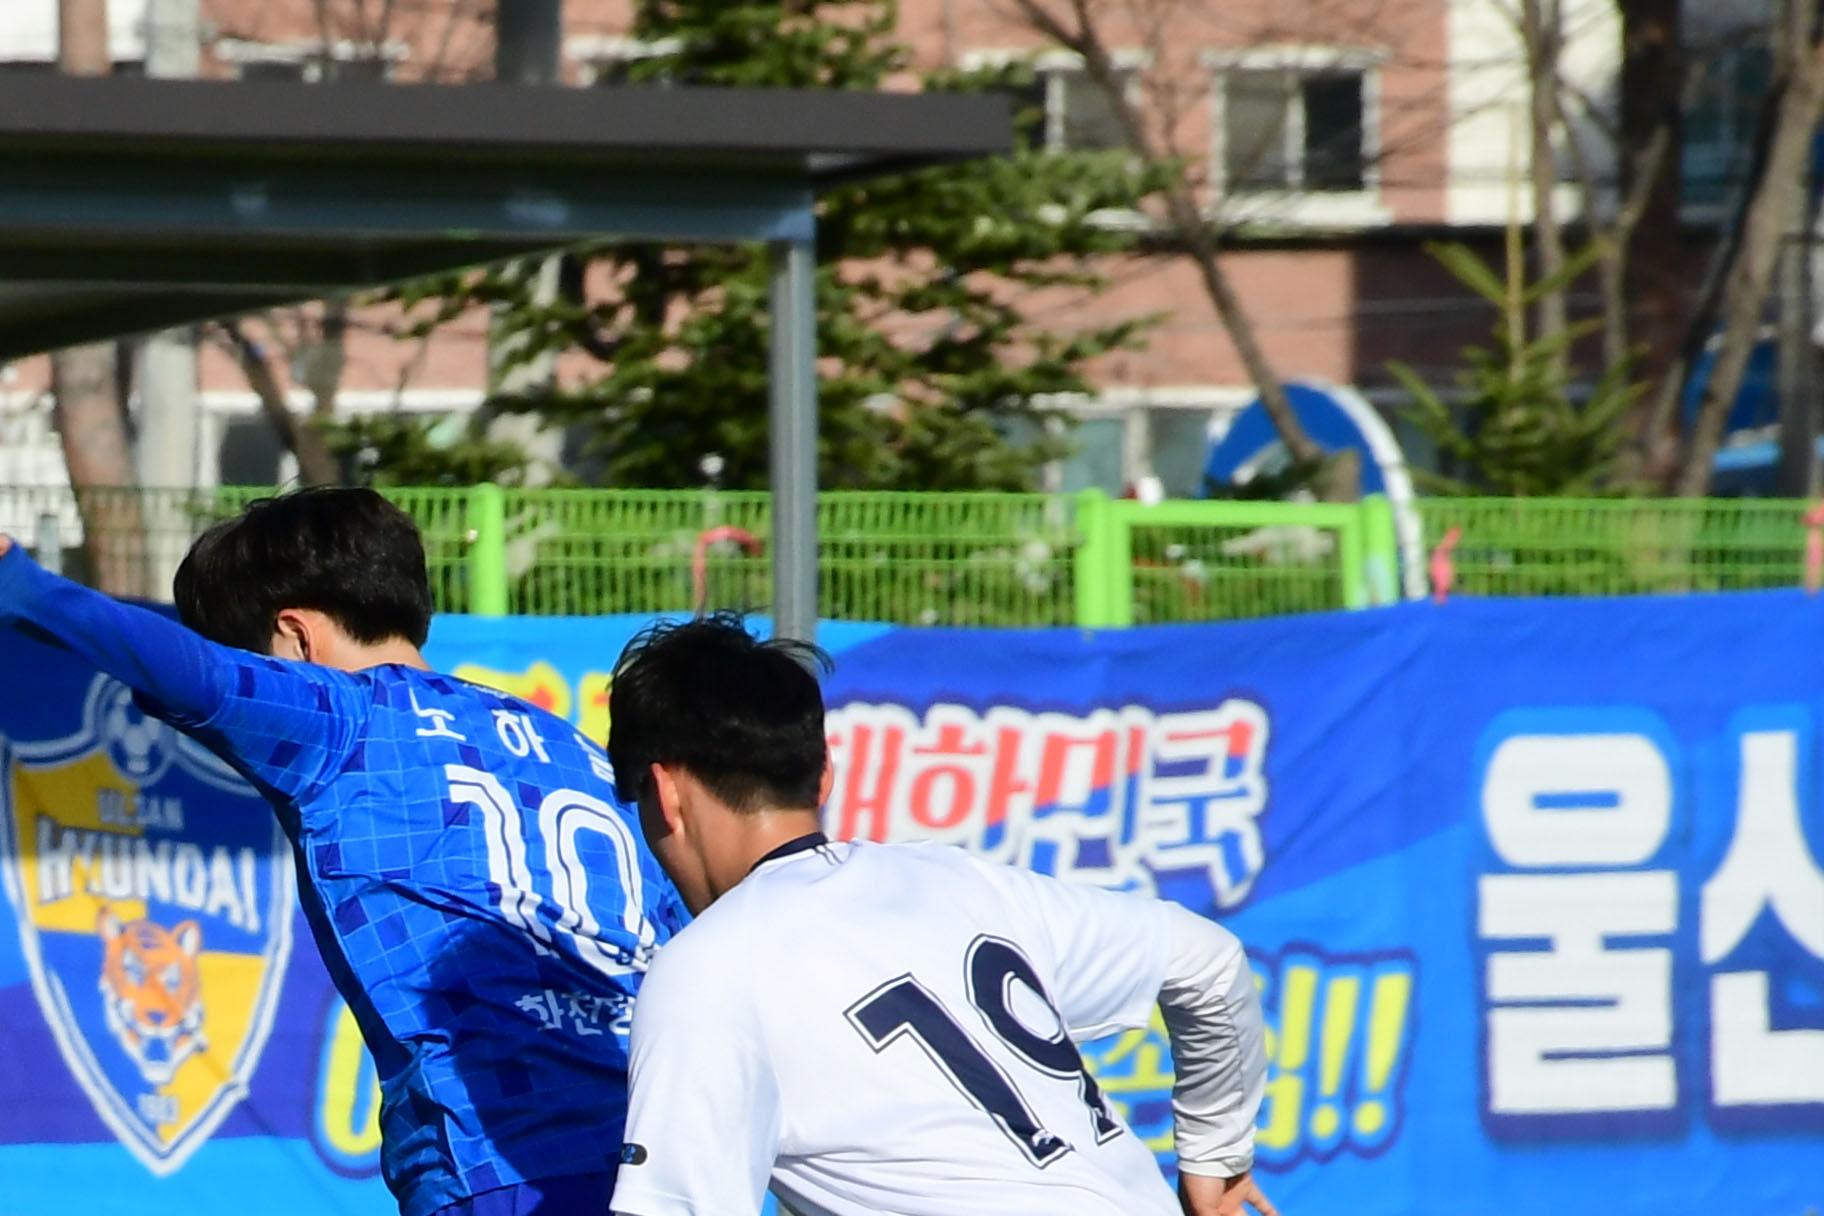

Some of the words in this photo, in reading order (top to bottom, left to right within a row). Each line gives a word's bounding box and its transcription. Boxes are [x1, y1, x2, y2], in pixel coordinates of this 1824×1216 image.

[37, 815, 260, 933] HYUNDAI
[444, 763, 661, 977] 10
[842, 933, 1124, 1170] 19
